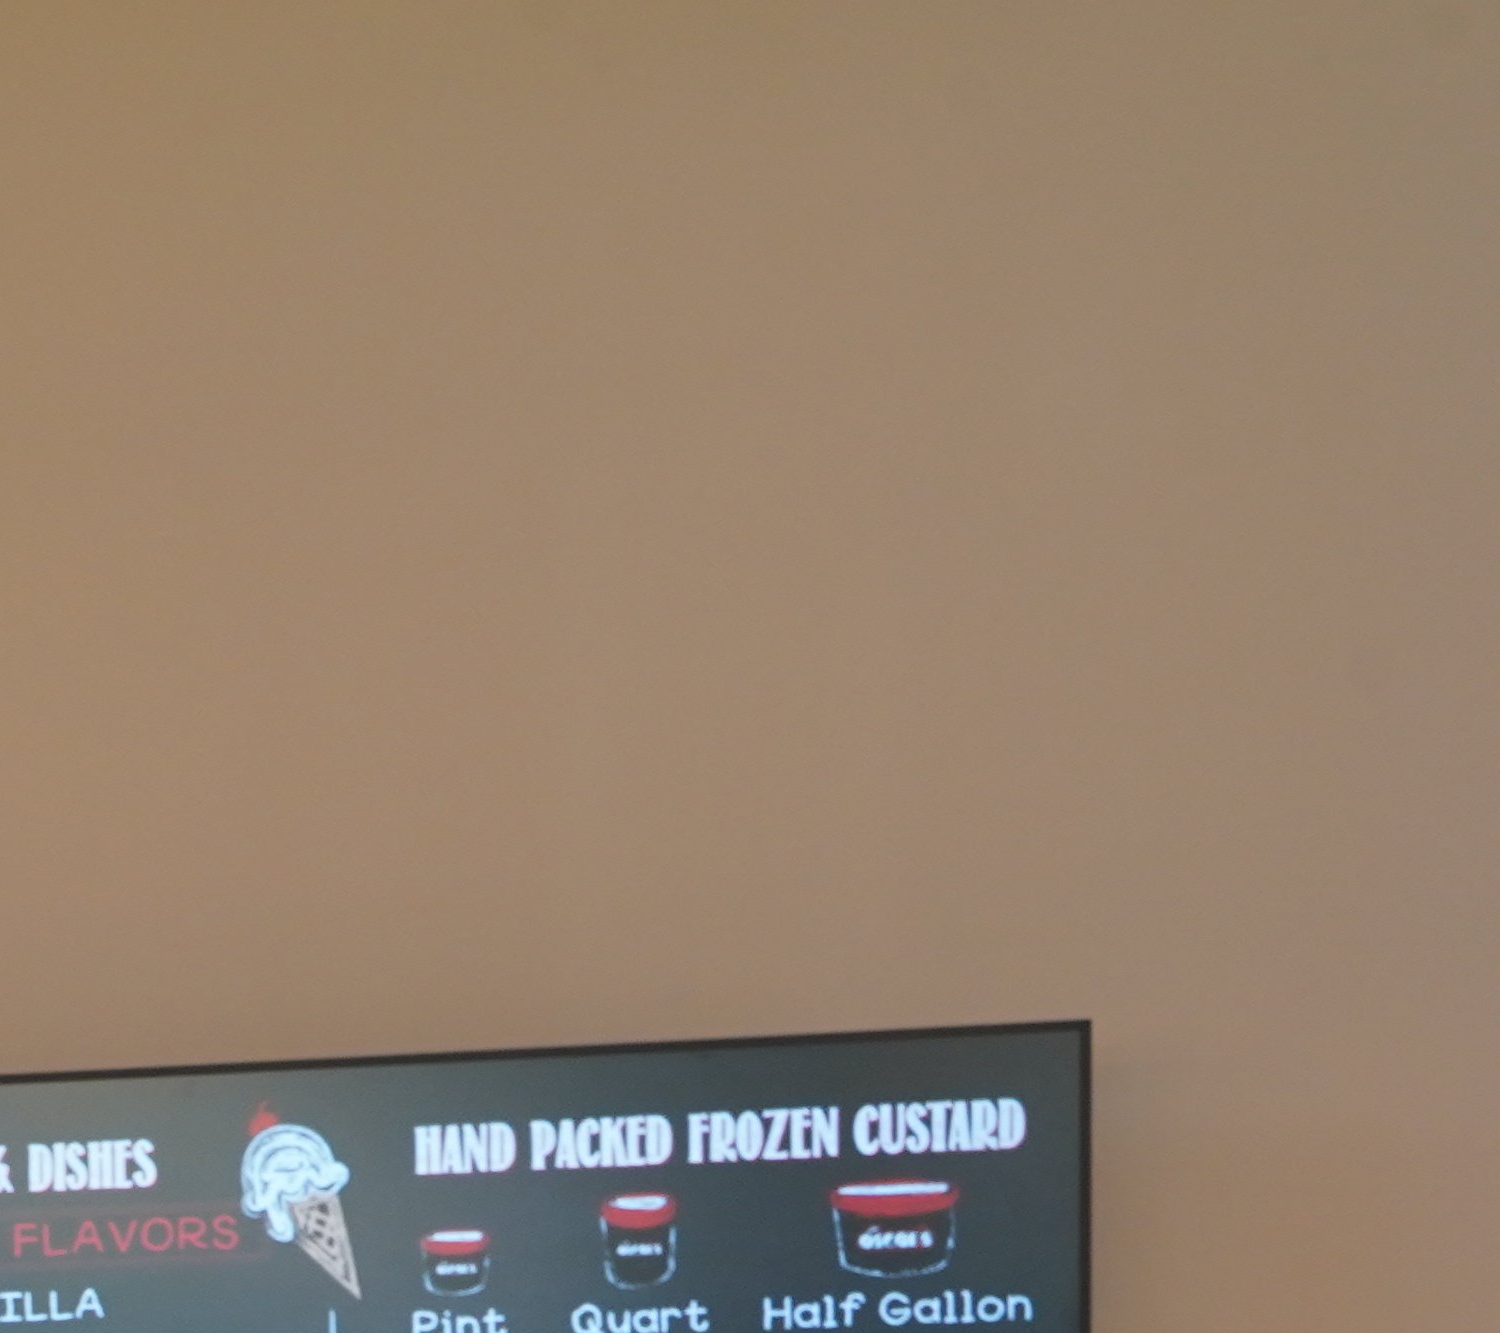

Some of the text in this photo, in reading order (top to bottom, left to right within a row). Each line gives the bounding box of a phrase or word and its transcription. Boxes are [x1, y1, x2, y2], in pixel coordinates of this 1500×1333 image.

[414, 1098, 1026, 1175] HAND PACKED FROZEN CUSTARD
[28, 1139, 157, 1192] DISHES
[12, 1214, 239, 1257] FLAVORS
[763, 1290, 1033, 1330] Half Gallon
